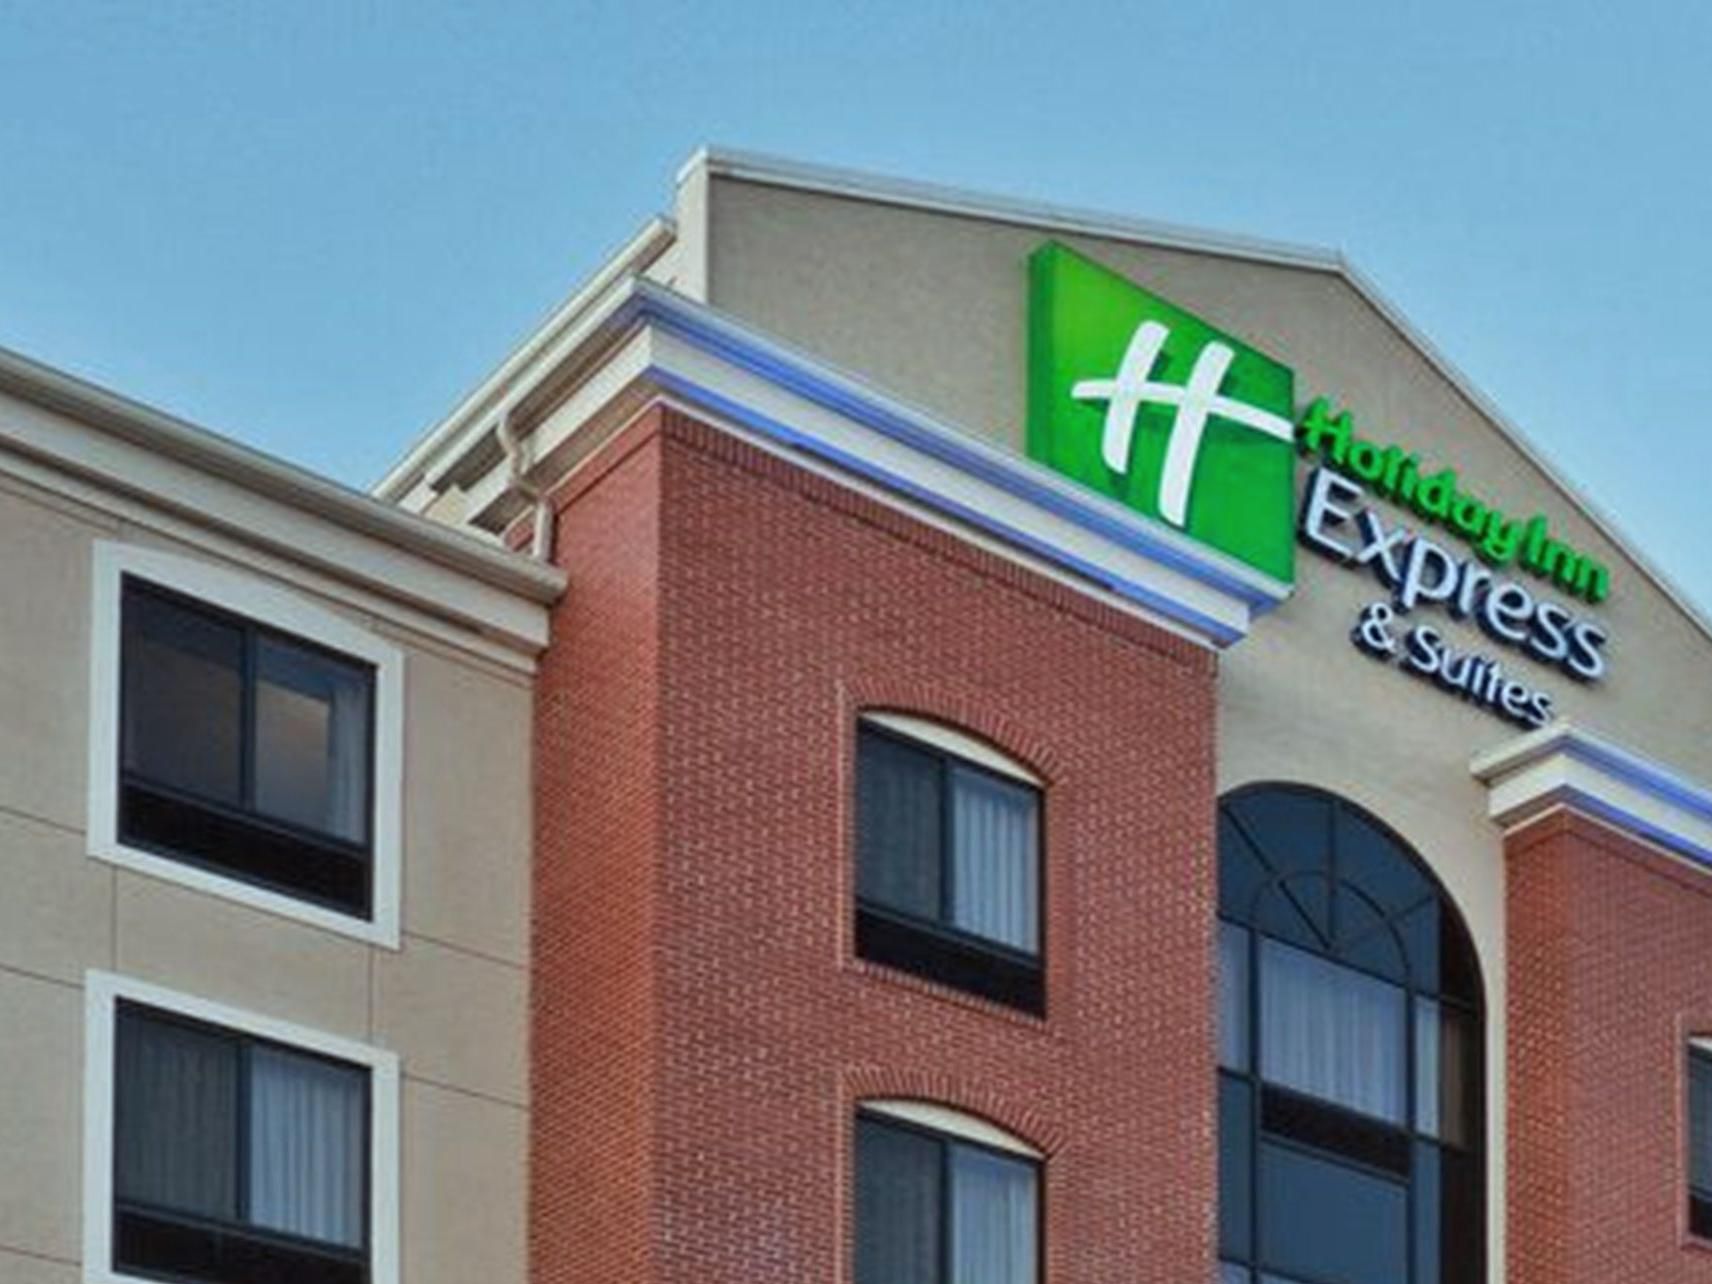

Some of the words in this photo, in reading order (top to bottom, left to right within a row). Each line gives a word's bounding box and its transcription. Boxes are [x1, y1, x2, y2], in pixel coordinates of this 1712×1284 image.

[1302, 399, 1517, 558] Holiday
[1519, 514, 1609, 602] Inn
[1305, 467, 1607, 679] Express
[1358, 602, 1396, 652] &
[1408, 624, 1553, 726] Suites
